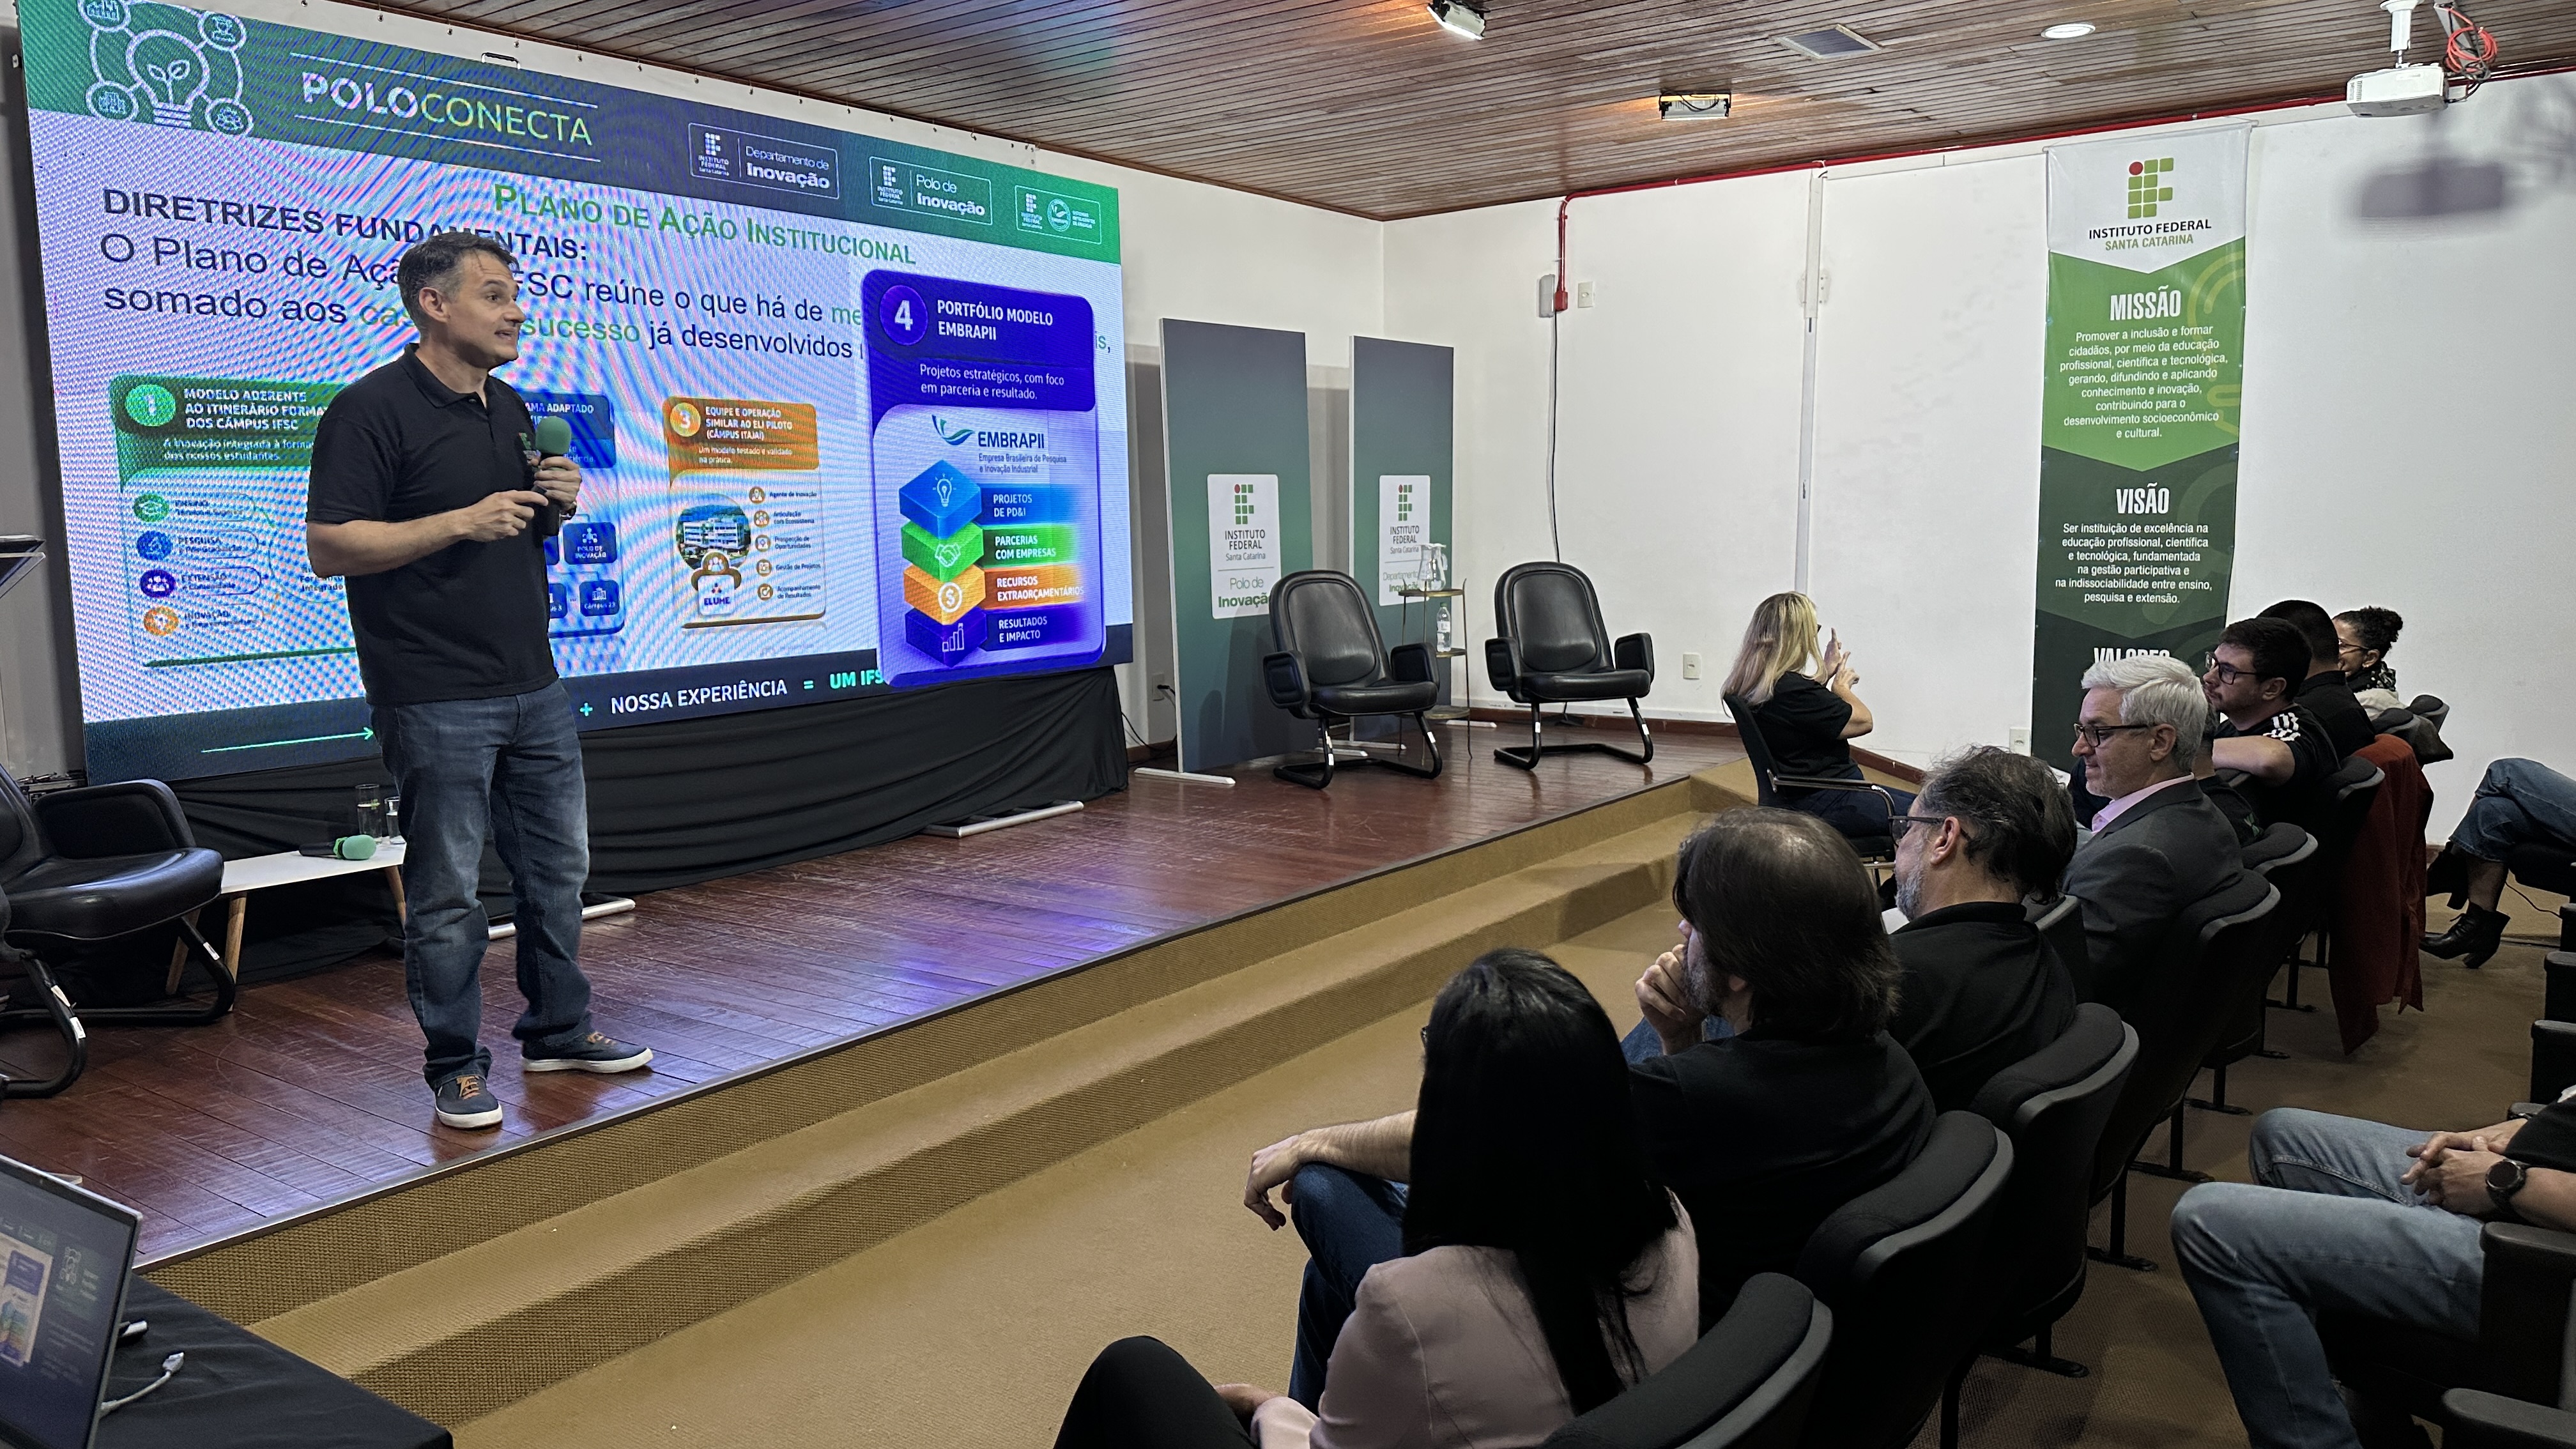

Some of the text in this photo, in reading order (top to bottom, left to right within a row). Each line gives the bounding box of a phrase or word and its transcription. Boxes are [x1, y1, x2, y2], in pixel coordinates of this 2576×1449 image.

[302, 72, 593, 146] POLOCONECTA
[746, 146, 829, 171] Departamento de
[746, 162, 830, 189] Inovação
[916, 174, 957, 194] Polo de
[917, 192, 985, 216] Inovação
[104, 189, 586, 261] DIRETRIZES FUNDANTAIS:
[494, 183, 602, 223] PLANO
[613, 205, 650, 230] DE
[747, 218, 917, 264] INSTITUCIONAL
[2089, 219, 2212, 240] INSTITUTO FEDERAL
[2105, 234, 2193, 251] SANTA CATARINA
[100, 233, 399, 291] O Plano de Açã
[105, 288, 347, 323] somado aos
[585, 279, 823, 321] reúne o que há de
[2110, 285, 2181, 321] MISSÃO
[894, 300, 913, 332] 4
[937, 300, 1054, 326] PORTFÓLIO MODELO
[520, 317, 640, 342] sucesso
[649, 321, 672, 349] já
[681, 324, 853, 358] desenvolvidos
[938, 321, 996, 341] EMBRAPII
[2076, 331, 2120, 342] Promover
[2131, 328, 2169, 339] inclusão
[2181, 325, 2213, 336] formar
[2069, 339, 2220, 357] cidadãos, por meio da educação
[2059, 359, 2115, 373] profissional,
[2117, 356, 2159, 369] científica
[2170, 353, 2228, 366] tecnológica,
[920, 364, 1064, 385] Projetos estratégicos, com foco
[2068, 374, 2108, 387] gerando,
[2110, 371, 2159, 383] difundindo
[2170, 367, 2218, 381] aplicando
[184, 388, 307, 402] MODELO ADERENTE
[921, 383, 1038, 400] em parceria e resultado.
[2081, 385, 2146, 397] conhecimento
[2157, 383, 2202, 395] inovação,
[185, 402, 328, 417] AO ITINERÁRIO FORMA
[547, 403, 594, 413] ADAPTADO
[2096, 398, 2186, 411] contribuindo para o
[679, 411, 691, 429] 3
[705, 406, 781, 420] EQUIPE E OPERAÇÃO
[2064, 411, 2220, 426] desenvolvimento socioeconômico
[187, 417, 299, 431] DOS CÂMPUS IFSC
[705, 418, 738, 429] SIMILAR
[740, 420, 751, 429] AO
[767, 420, 793, 431] PILOTO
[978, 431, 1045, 449] EMBRAPII
[2116, 427, 2163, 439] e cultural.
[979, 453, 1067, 464] Empresa Brasileira de Pesquisa
[985, 464, 1011, 475] Inovação
[1012, 464, 1038, 473] Industrial
[993, 494, 1032, 504] PROJETOS
[2115, 482, 2170, 514] VISÃO
[993, 507, 1026, 518] DE PD&I
[1224, 529, 1266, 540] INSTITUTO
[1390, 525, 1419, 535] INSTITUTO
[2063, 523, 2209, 535] Ser instituição de excelência na
[995, 535, 1038, 547] PARCERIAS
[1229, 539, 1262, 551] FEDERAL
[1393, 535, 1417, 544] FEDERAL
[2062, 537, 2209, 549] educação profissional, científica
[995, 548, 1056, 560] COM EMPRESAS
[1225, 551, 1266, 561] Santa Catarina
[2076, 551, 2131, 563] tecnológica,
[2133, 551, 2201, 562] fundamentada
[2077, 566, 2089, 574] na
[2091, 565, 2122, 576] gestão
[2124, 565, 2181, 576] participativa
[997, 576, 1038, 588] RECURSOS
[1230, 576, 1264, 590] Polo de
[2055, 578, 2212, 592] na indissociabilidade entre ensino,
[997, 585, 1084, 602] EXTRAORÇAMENTÁRIOS
[1218, 592, 1268, 608] Inovaçã
[2083, 592, 2125, 604] pesquisa
[2135, 593, 2181, 604] extensão.
[703, 597, 731, 606] ELUME
[999, 616, 1048, 629] RESULTADOS
[999, 630, 1041, 643] E IMPACTO
[611, 671, 856, 715] NOSSA EXPERIÊNCIA UM
